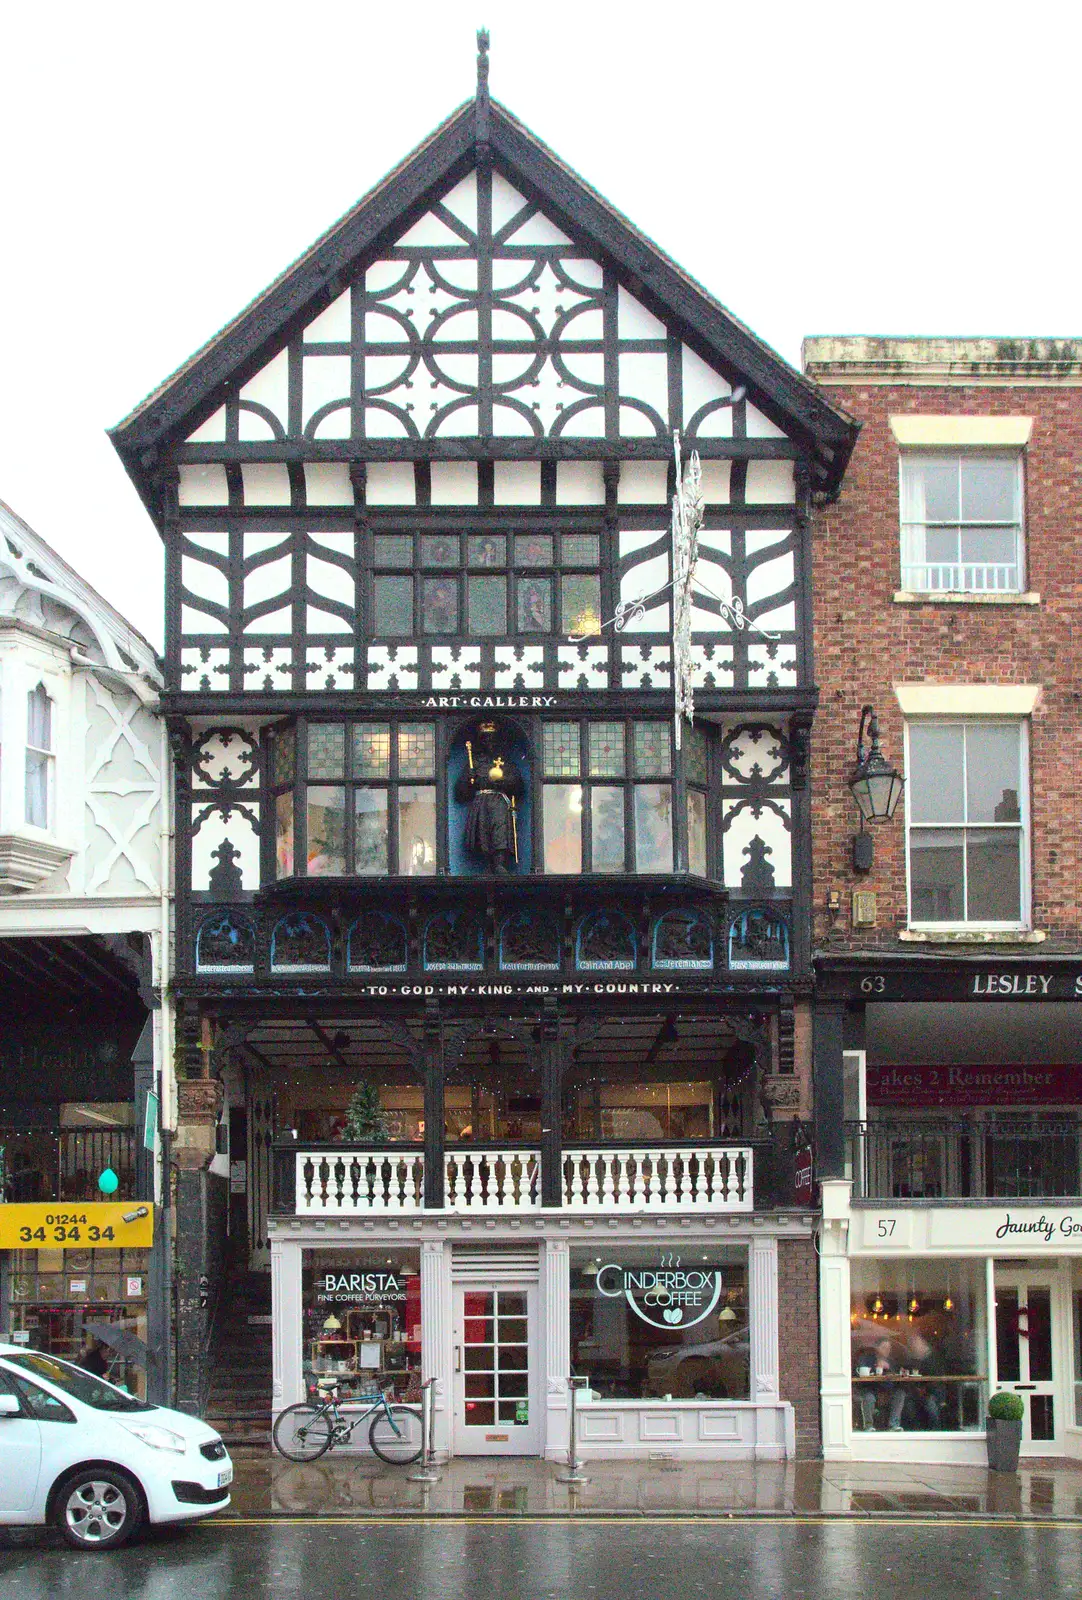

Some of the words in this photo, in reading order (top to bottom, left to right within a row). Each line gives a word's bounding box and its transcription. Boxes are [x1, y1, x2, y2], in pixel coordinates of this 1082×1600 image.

[425, 697, 460, 707] ART
[470, 696, 554, 707] GALLERY
[367, 986, 388, 995] TO
[401, 986, 434, 995] GOD
[448, 985, 469, 995] MY
[478, 985, 513, 994] KING
[562, 985, 584, 993] MY
[594, 983, 673, 993] COUNTRY
[860, 976, 885, 993] 63
[973, 975, 1054, 994] LESLEY
[929, 1071, 941, 1085] 2
[949, 1067, 1053, 1085] Remember
[45, 1214, 88, 1225] 01244
[878, 1219, 896, 1237] 57
[996, 1213, 1056, 1241] Jaunty
[20, 1226, 46, 1242] 34
[54, 1226, 81, 1241] 34
[88, 1225, 115, 1241] 34
[325, 1274, 399, 1291] BARISTA
[317, 1294, 333, 1302] FINE
[335, 1294, 363, 1302] COFFEE
[644, 1291, 702, 1306] COFFEE
